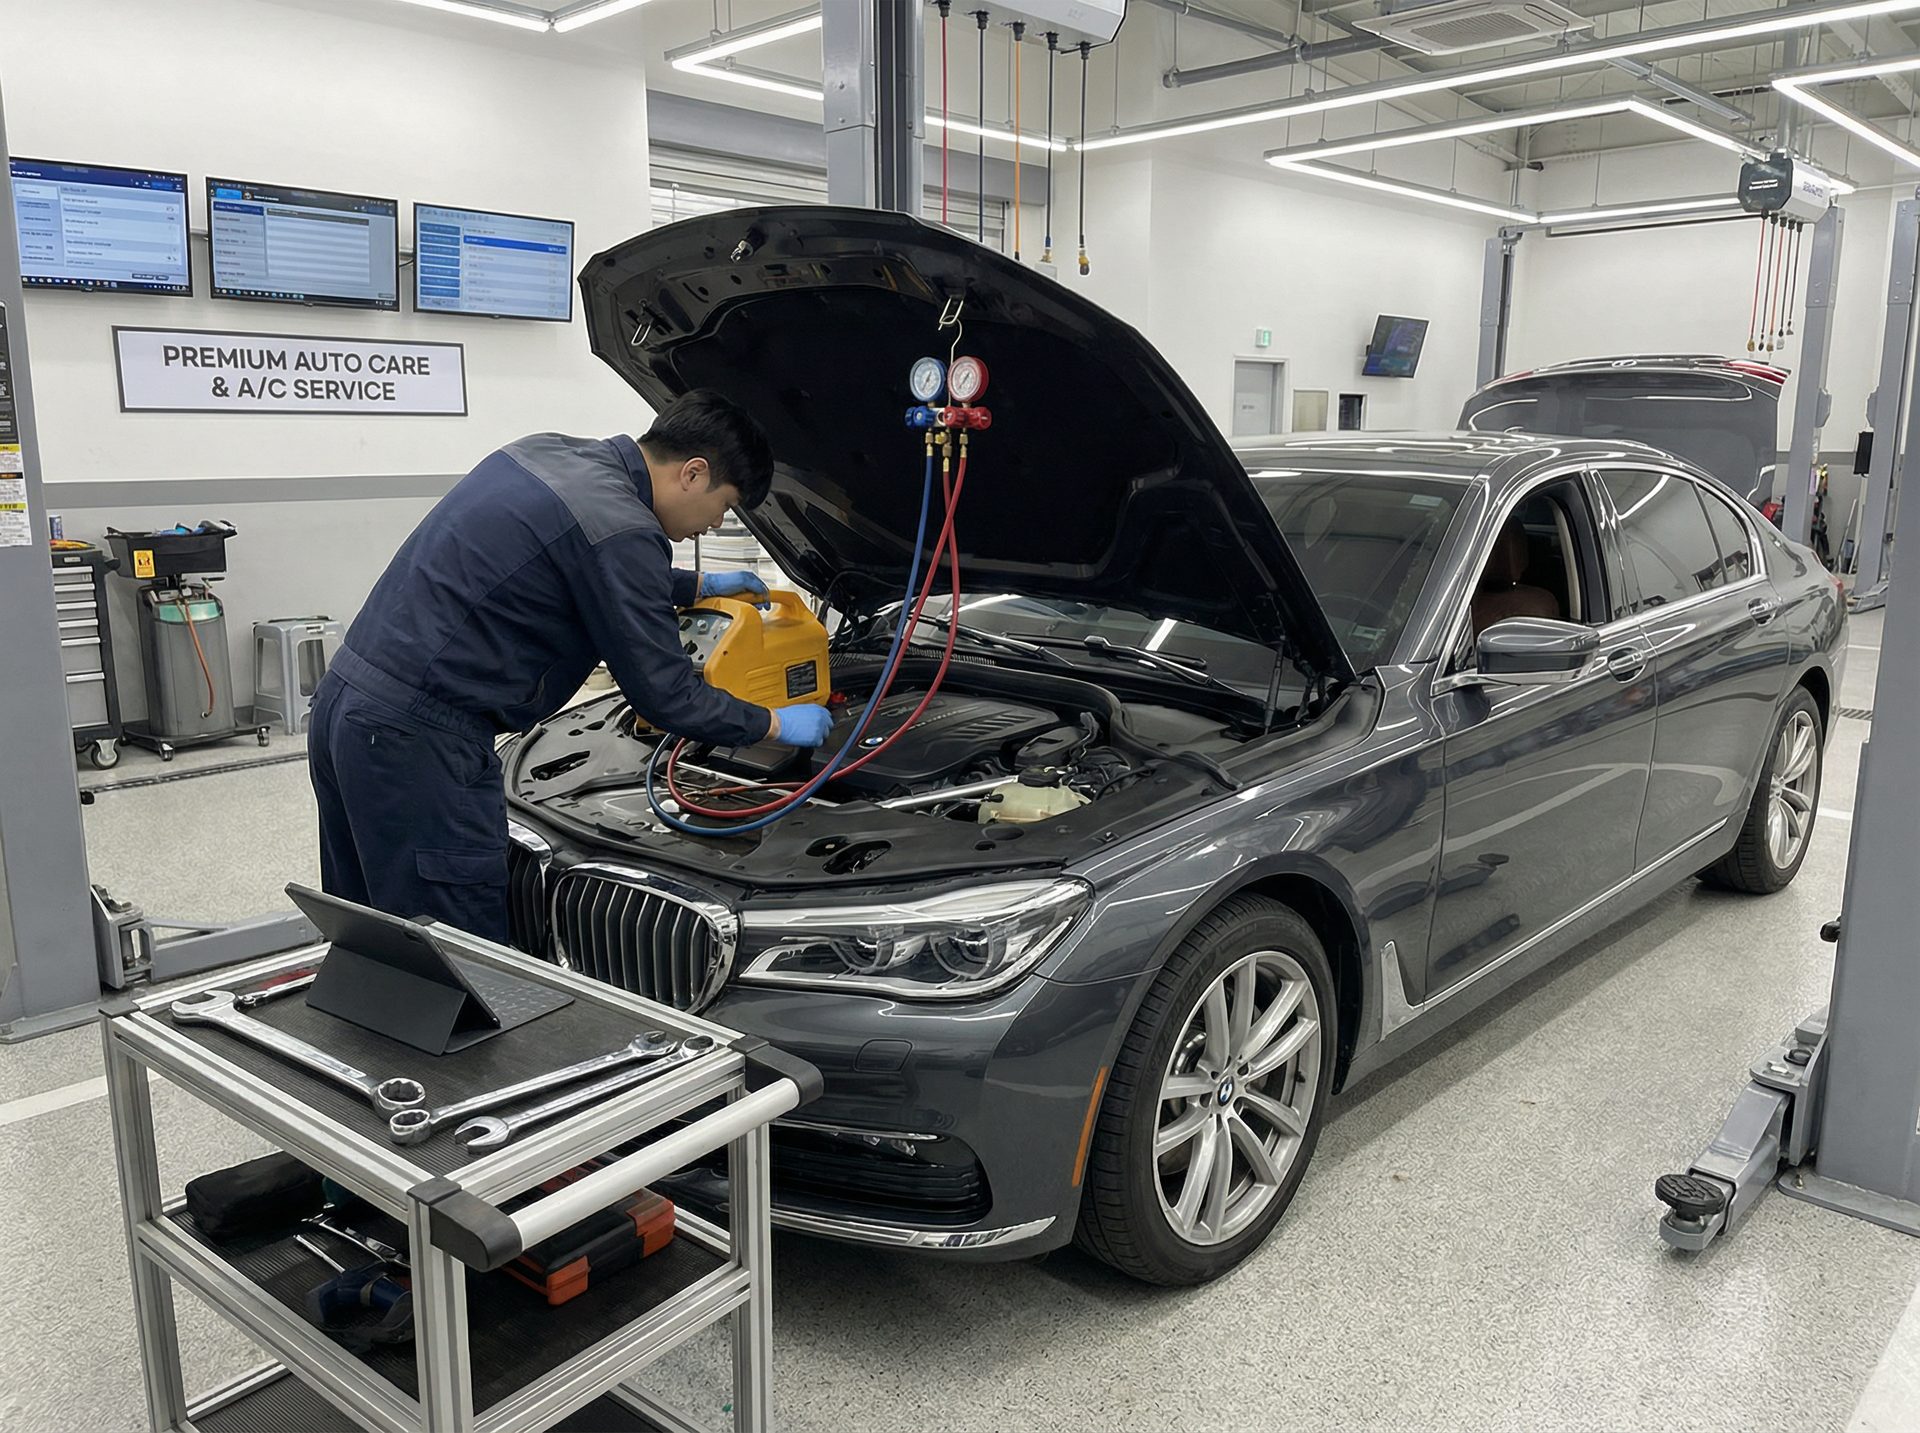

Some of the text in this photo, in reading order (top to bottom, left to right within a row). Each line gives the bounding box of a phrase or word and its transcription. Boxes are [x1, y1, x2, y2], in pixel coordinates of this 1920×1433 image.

[163, 346, 430, 375] PREMIUM AUTO CARE
[212, 377, 395, 400] & A/C SERVICE
